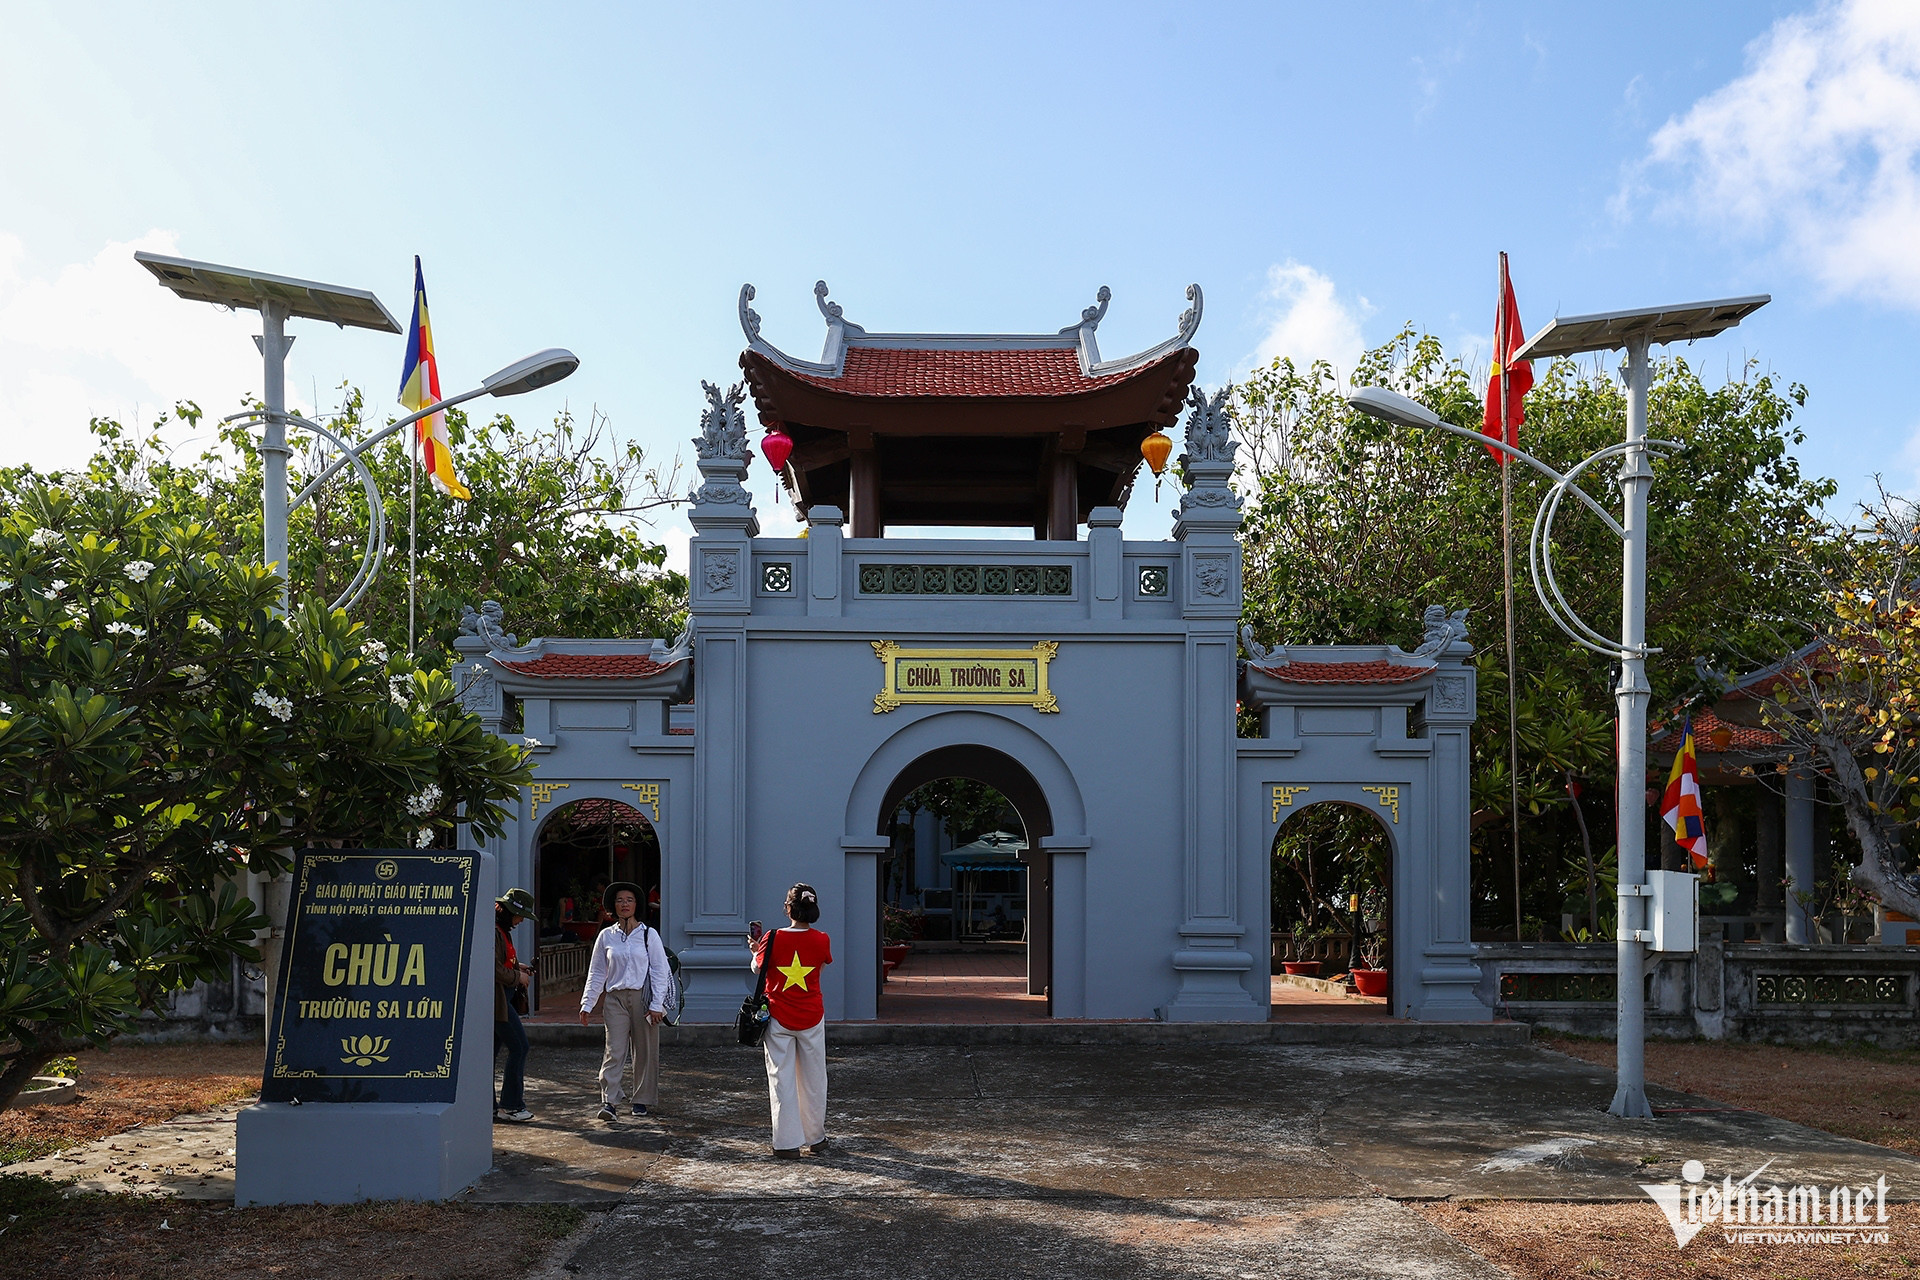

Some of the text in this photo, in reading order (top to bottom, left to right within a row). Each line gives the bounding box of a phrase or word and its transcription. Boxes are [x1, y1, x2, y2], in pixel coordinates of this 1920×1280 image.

[907, 664, 1026, 688] CHÙA TRƯỜNG SA
[315, 881, 453, 903] GIÁO HỘI PHẬT GIÁO VIỆT NAM
[329, 903, 346, 917] HỘI
[349, 904, 375, 917] PHẬT
[377, 904, 401, 915] GIÁO
[403, 904, 436, 916] KHÁNH
[438, 904, 459, 916] HÒA
[322, 933, 426, 987] CHÙA
[299, 996, 442, 1019] TRƯỜNG SA LỚN
